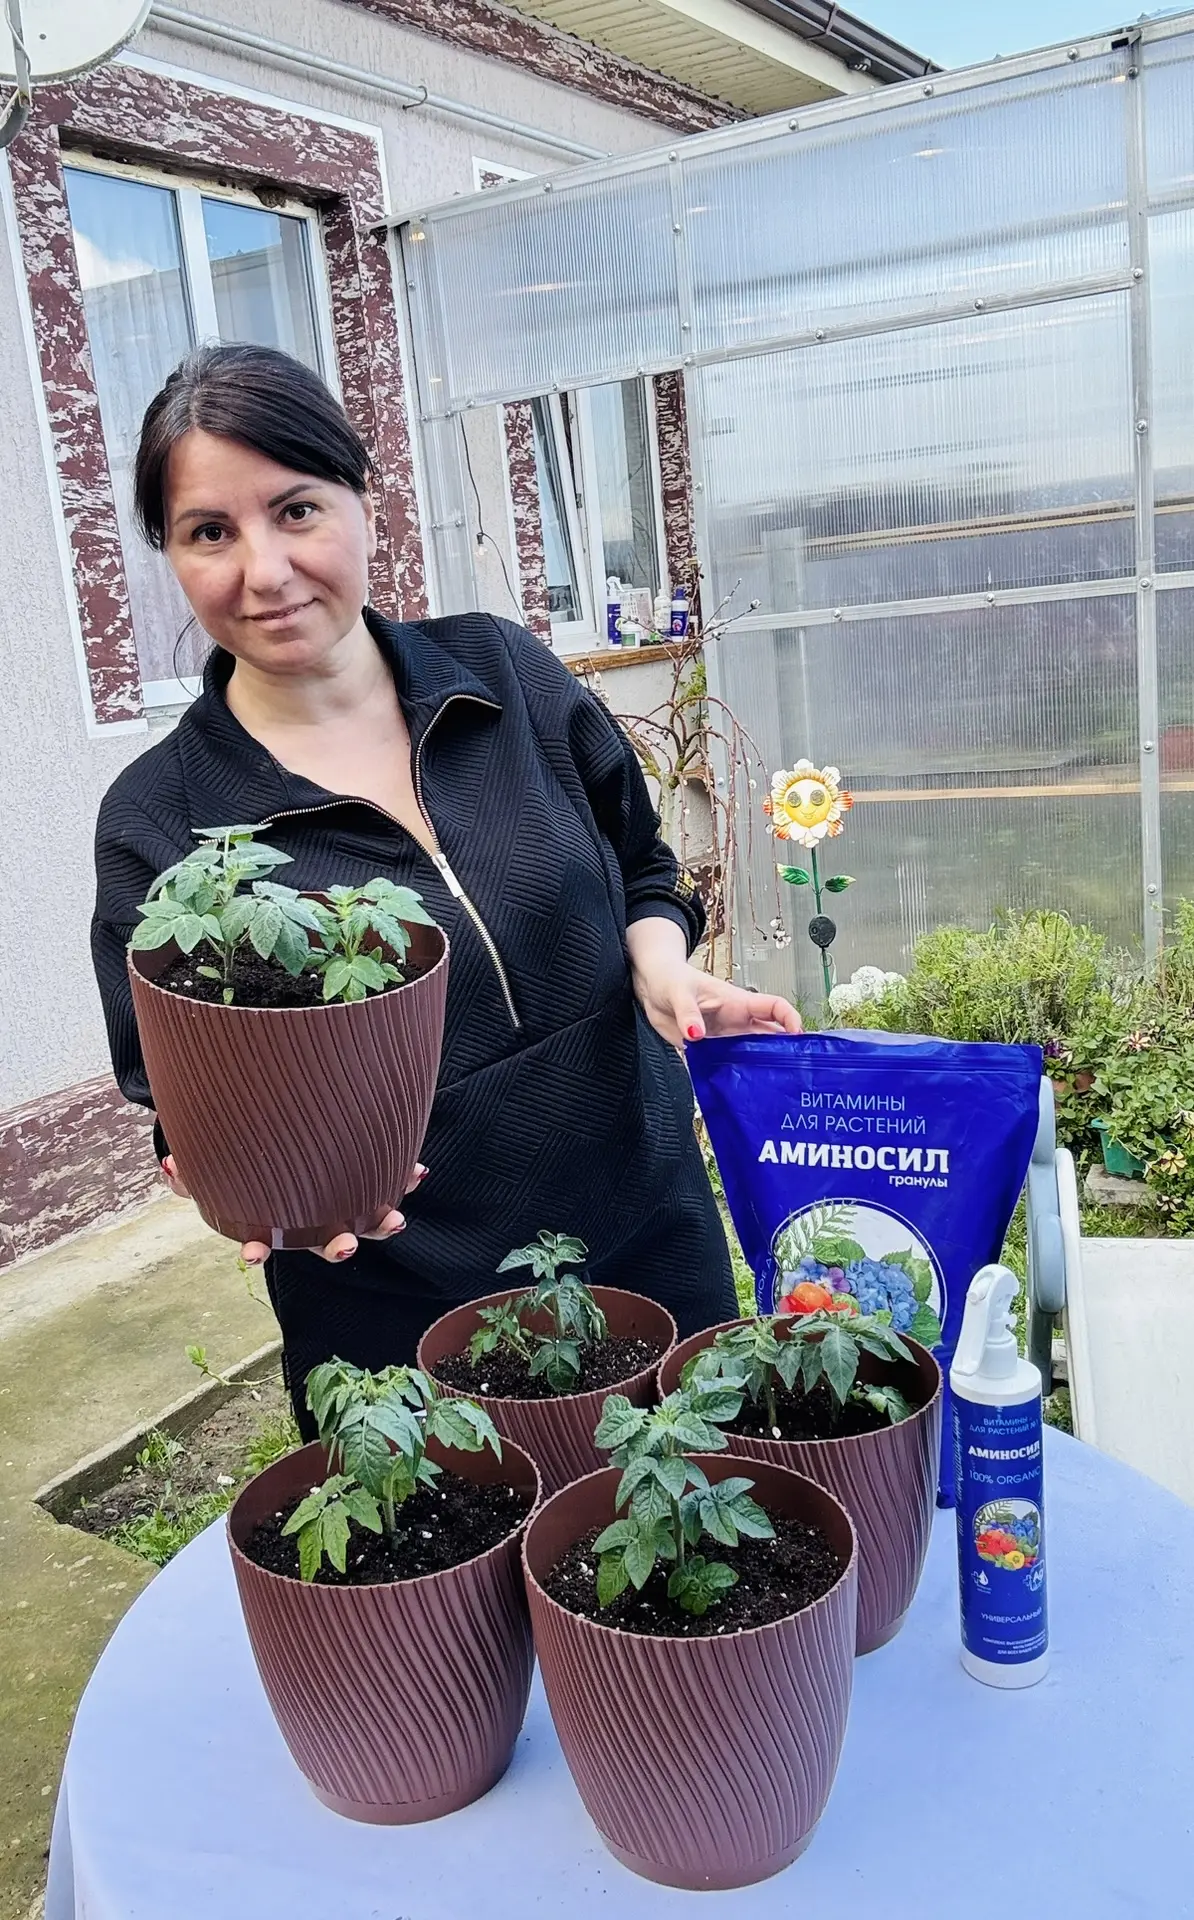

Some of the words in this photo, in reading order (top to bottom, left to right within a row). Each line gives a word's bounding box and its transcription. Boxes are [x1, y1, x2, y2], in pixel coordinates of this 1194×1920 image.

[801, 1092, 905, 1111] ВИТАМИНЫ
[781, 1113, 818, 1130] ДЛЯ
[825, 1115, 926, 1135] РАСТЕНИЙ
[758, 1139, 950, 1174] АМИНОСИЛ
[889, 1174, 948, 1189] гранулы
[969, 1423, 985, 1433] ДЛЯ
[988, 1423, 1029, 1435] РАСТЕНИЙ
[983, 1416, 1028, 1426] ВИТАМИНЫ
[968, 1440, 1040, 1460] АМИНОСИЛ
[969, 1469, 994, 1484] 100%
[996, 1465, 1041, 1485] ORGANIC
